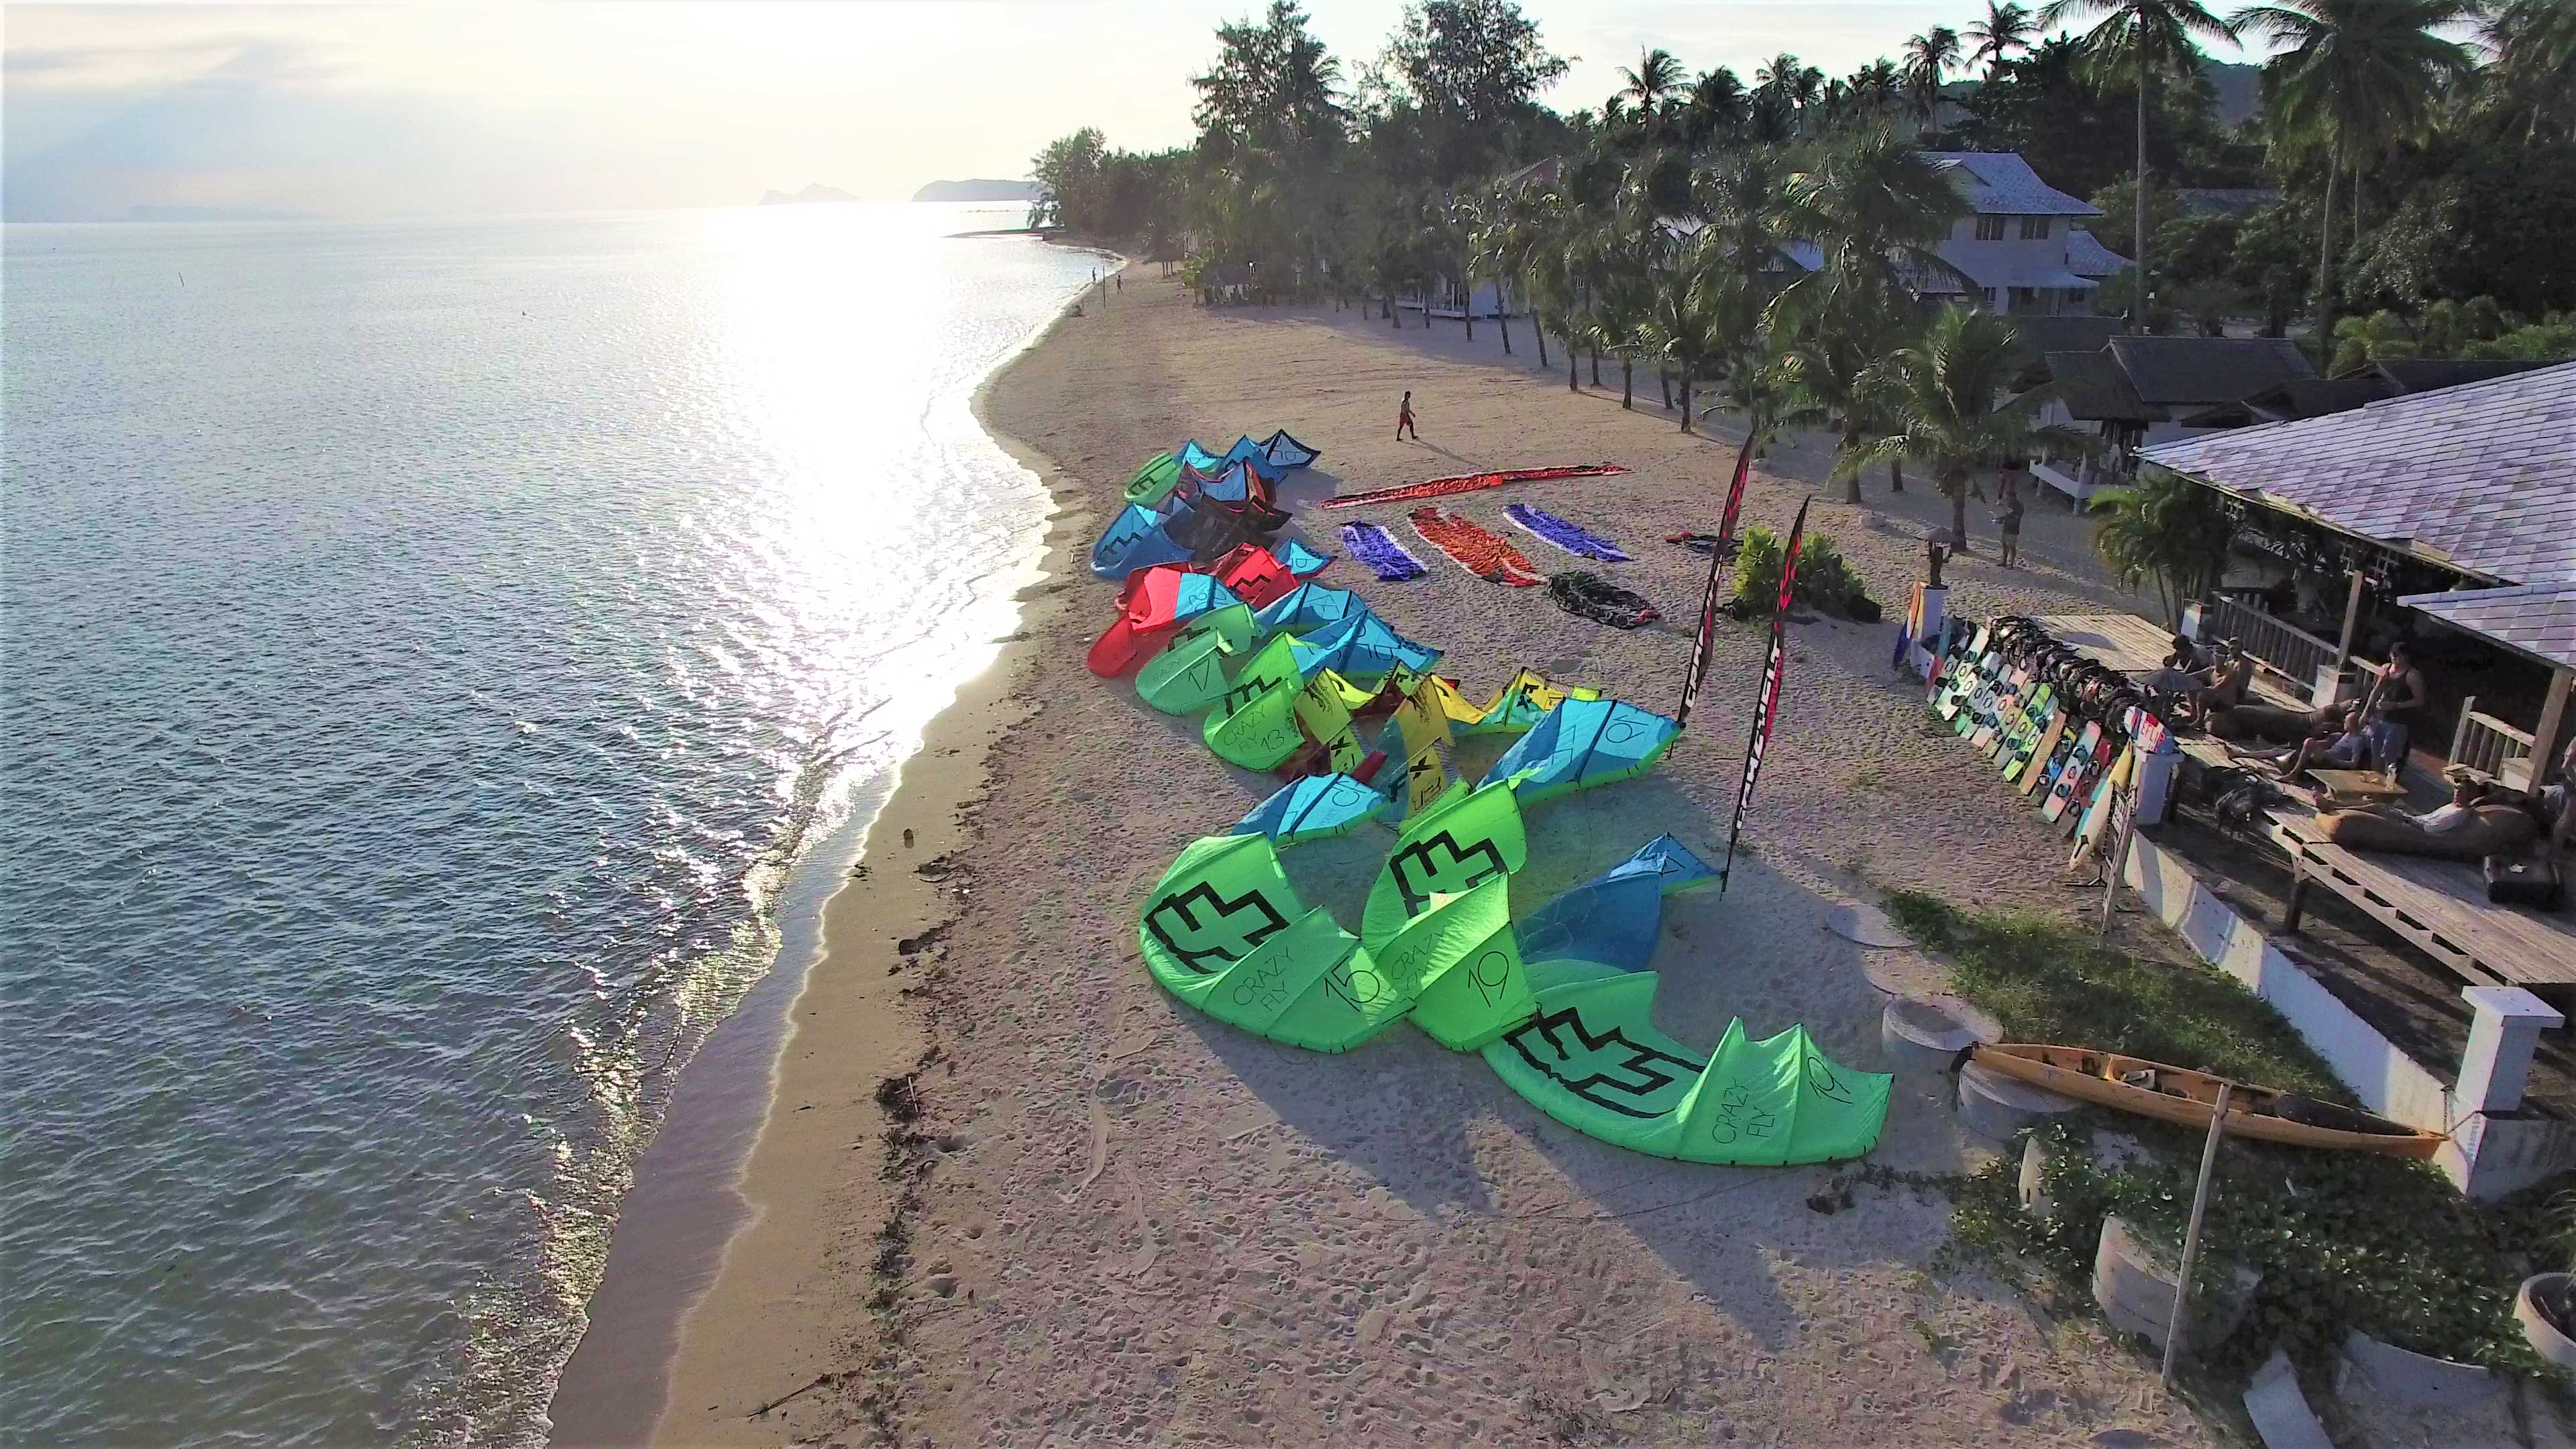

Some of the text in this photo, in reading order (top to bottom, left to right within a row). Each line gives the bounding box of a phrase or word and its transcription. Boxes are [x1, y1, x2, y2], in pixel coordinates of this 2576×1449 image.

[1224, 704, 1265, 746] CRAZY
[1260, 729, 1285, 752] 13
[1233, 947, 1295, 1006] CRAZY
[1260, 980, 1289, 1012] FLY
[1325, 955, 1381, 1012] 15
[1467, 951, 1509, 1008] 19
[1712, 1076, 1750, 1144] CRAZY
[1746, 1106, 1776, 1138] FLY
